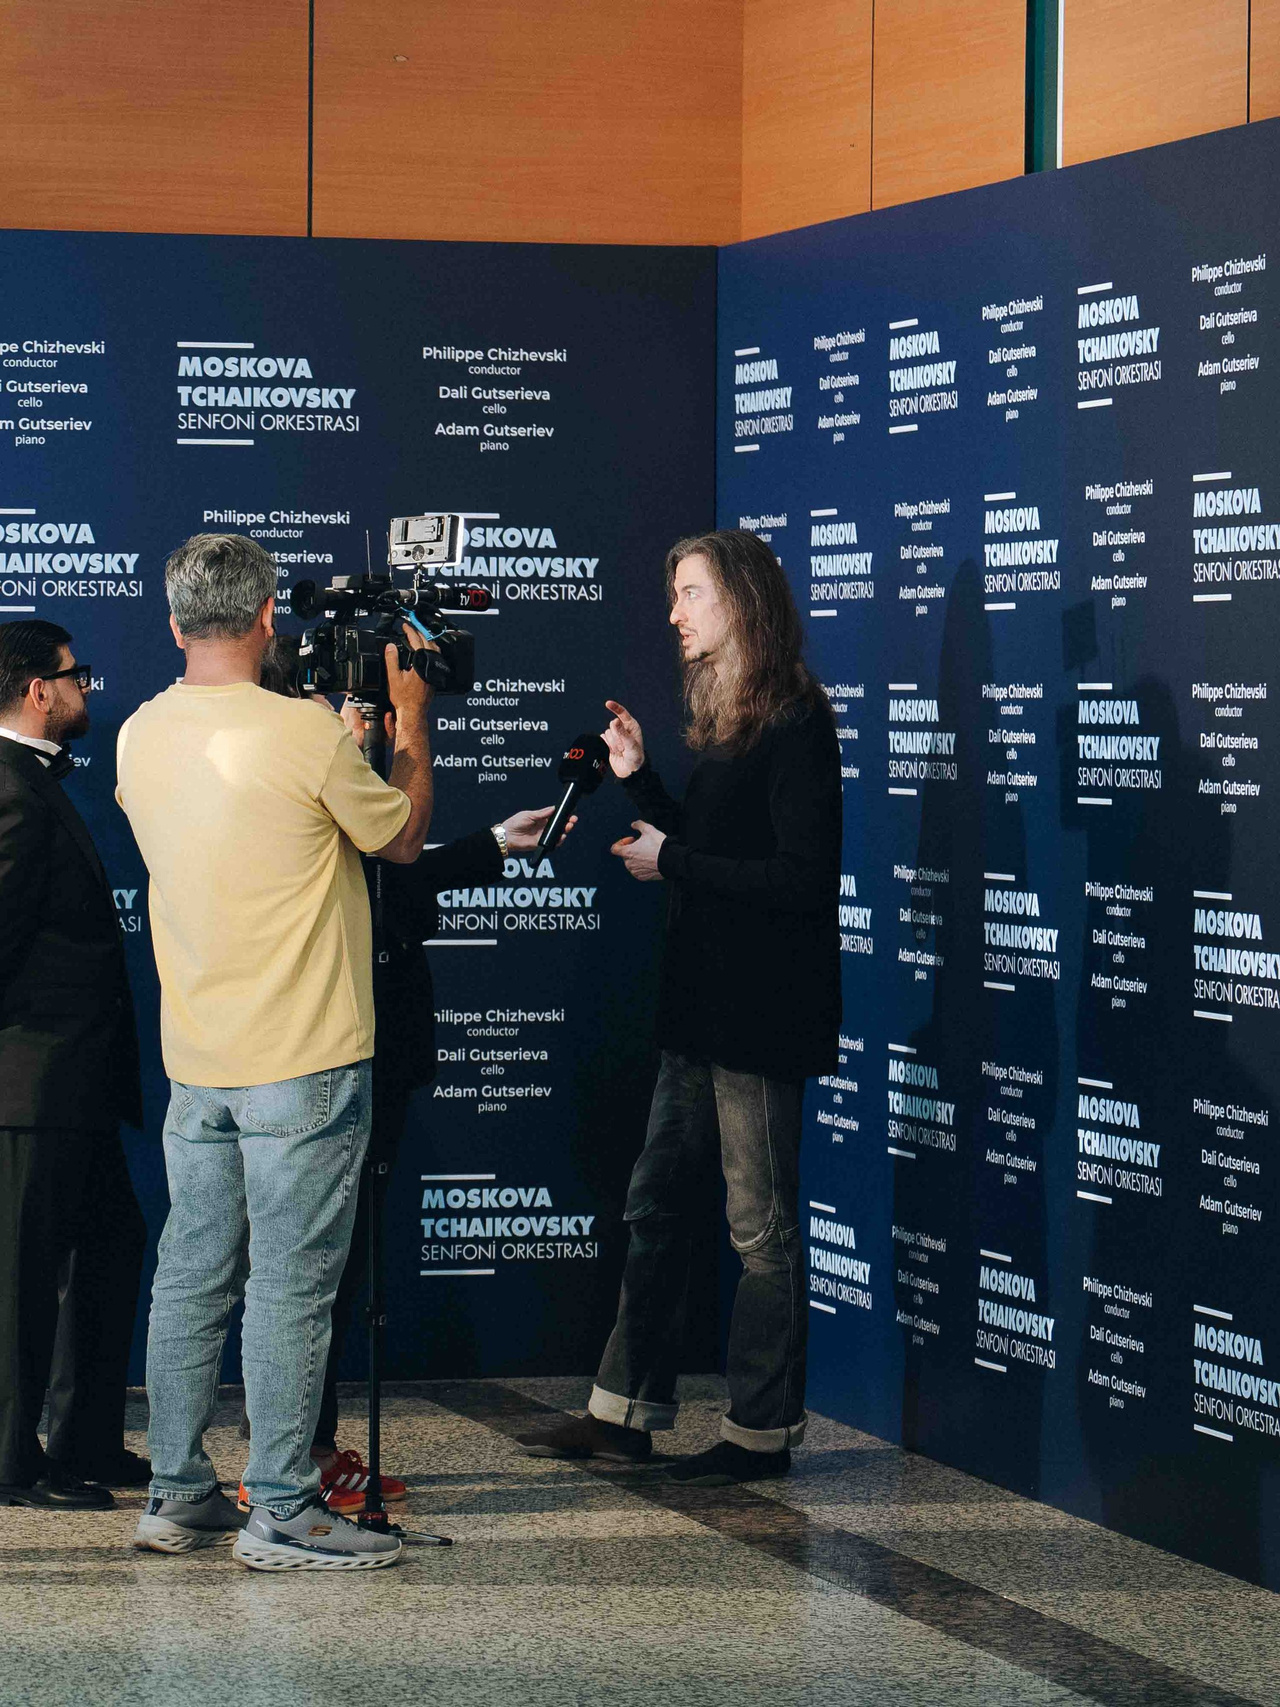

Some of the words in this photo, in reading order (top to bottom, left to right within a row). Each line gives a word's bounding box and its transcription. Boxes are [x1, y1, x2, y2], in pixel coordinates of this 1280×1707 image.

[1192, 264, 1223, 283] Philippe
[1224, 253, 1265, 276] Chizhevski
[1215, 282, 1242, 296] conductor
[1078, 295, 1139, 329] MOSKOVA
[1200, 312, 1214, 330] Dali
[1216, 308, 1257, 327] Gutserieva
[23, 340, 105, 354] Chizhevski
[890, 331, 940, 360] MOSKOVA
[1078, 328, 1159, 363] TCHAIKOVSKY
[1222, 331, 1234, 345] cello
[3, 357, 58, 367] conductor
[423, 346, 484, 362] Philippe
[487, 348, 566, 361] Chizhevski
[178, 356, 313, 378] MOSKOVA
[468, 364, 521, 375] conductor
[735, 359, 778, 385] MOSKOVA
[1078, 363, 1112, 391] SENFONİ
[1115, 360, 1161, 385] ORKESTRASI
[1198, 360, 1220, 376] Adam
[1222, 354, 1259, 373] Gutseriev
[6, 380, 88, 393] Gutserieva
[890, 361, 956, 392] TCHAIKOVSKY
[1221, 379, 1236, 395] piano
[18, 397, 43, 407] cello
[177, 386, 356, 409] TCHAIKOVSKY
[439, 386, 467, 398] Dali
[472, 387, 550, 400] Gutserieva
[735, 387, 792, 414] TCHAIKOVSKY
[483, 403, 507, 414] cello
[890, 393, 918, 417] SENFONİ
[920, 391, 957, 413] ORKESTRASI
[19, 417, 92, 430] Gutseriev
[178, 411, 254, 430] SENFONİ
[260, 414, 359, 432] ORKESTRASI
[435, 423, 479, 435] Adam
[483, 424, 554, 437] Gutseriev
[735, 415, 759, 437] SENFONİ
[761, 414, 793, 434] ORKESTRASI
[15, 434, 45, 447] piano
[480, 440, 509, 452] piano
[1193, 488, 1261, 517] MOSKOVA
[204, 510, 265, 526] Philippe
[269, 511, 350, 524] Chizhevski
[985, 507, 1040, 534] MOSKOVA
[250, 527, 304, 538] conductor
[463, 527, 557, 548] SKOVA
[811, 522, 857, 546] MOSKOVA
[271, 550, 333, 563] tserieva
[985, 539, 1058, 567] TCHAIKOVSKY
[275, 567, 289, 577] llo
[811, 553, 872, 577] TCHAIKOVSKY
[1194, 557, 1232, 583] SENFONİ
[42, 580, 142, 597] ORKESTRASI
[811, 580, 837, 601] SENFONİ
[839, 581, 873, 599] ORKESTRASI
[985, 570, 1016, 593] SENFONİ
[1018, 571, 1060, 591] ORKESTRASI
[506, 584, 602, 601] ORKESTRASI
[486, 679, 565, 692] Chizhevski
[1192, 683, 1223, 702] Philippe
[1225, 683, 1266, 699] Chizhevski
[467, 695, 519, 706] conductor
[1215, 704, 1242, 717] conductor
[1078, 700, 1139, 725] MOSKOVA
[438, 718, 466, 730] Dali
[470, 718, 548, 730] Gutserieva
[481, 735, 505, 745] cello
[1078, 735, 1160, 761] TCHAIKOVSKY
[1201, 732, 1215, 748] Dali
[1217, 733, 1258, 749] Gutserieva
[433, 755, 477, 767] Adam
[482, 754, 552, 767] Gutseriev
[1222, 754, 1235, 767] cello
[478, 771, 507, 783] piano
[1078, 764, 1112, 787] SENFONİ
[1115, 768, 1161, 789] ORKESTRASI
[1198, 778, 1221, 794] Adam
[1223, 780, 1260, 796] Gutseriev
[1221, 801, 1236, 816] piano
[437, 887, 597, 908] CHAIKOVSKY
[984, 889, 1040, 916] MOSKOVA
[438, 911, 498, 931] NFONİ
[504, 914, 600, 930] ORKESTRASI
[1194, 909, 1262, 940] MOSKOVA
[984, 922, 1058, 953] TCHAIKOVSKY
[984, 952, 1015, 974] SENFONİ
[1017, 956, 1059, 980] ORKESTRASI
[1194, 978, 1232, 1002] SENFONİ
[1235, 984, 1280, 1009] ORKESTRA
[434, 1009, 482, 1025] ilippe
[486, 1009, 564, 1022] Chizhevski
[467, 1026, 519, 1036] conductor
[438, 1048, 465, 1061] Dali
[470, 1048, 548, 1061] Gutserieva
[481, 1065, 505, 1075] cello
[433, 1085, 477, 1097] Adam
[481, 1084, 552, 1097] Gutseriev
[478, 1102, 507, 1114] piano
[1078, 1094, 1140, 1129] MOSKOVA
[1194, 1098, 1225, 1120] Philippe
[1226, 1105, 1268, 1126] Chizhevski
[1217, 1125, 1244, 1140] conductor
[1078, 1129, 1160, 1168] TCHAIKOVSKY
[1202, 1149, 1216, 1166] Dali
[1218, 1152, 1259, 1174] Gutserieva
[1078, 1161, 1112, 1186] SENFONİ
[1115, 1169, 1161, 1197] ORKESTRASI
[1224, 1174, 1237, 1188] cello
[421, 1188, 553, 1209] MOSKOVA
[1200, 1195, 1222, 1213] Adam
[1224, 1200, 1262, 1222] Gutseriev
[421, 1216, 595, 1238] TCHAIKOVSKY
[1223, 1220, 1238, 1235] piano
[421, 1241, 496, 1261] SENFONİ
[501, 1242, 598, 1259] ORKESTRASI
[979, 1266, 1036, 1302] MOSKOVA
[978, 1298, 1055, 1342] TCHAIKOVSKY
[976, 1329, 1009, 1356] SENFONİ
[1010, 1339, 1055, 1370] ORKESTRASI
[1194, 1323, 1263, 1366] MOSKOVA
[1194, 1358, 1280, 1408] TCHAIKOVSK
[1194, 1392, 1233, 1423] SENFONİ
[1236, 1405, 1280, 1438] ORKESTRA
